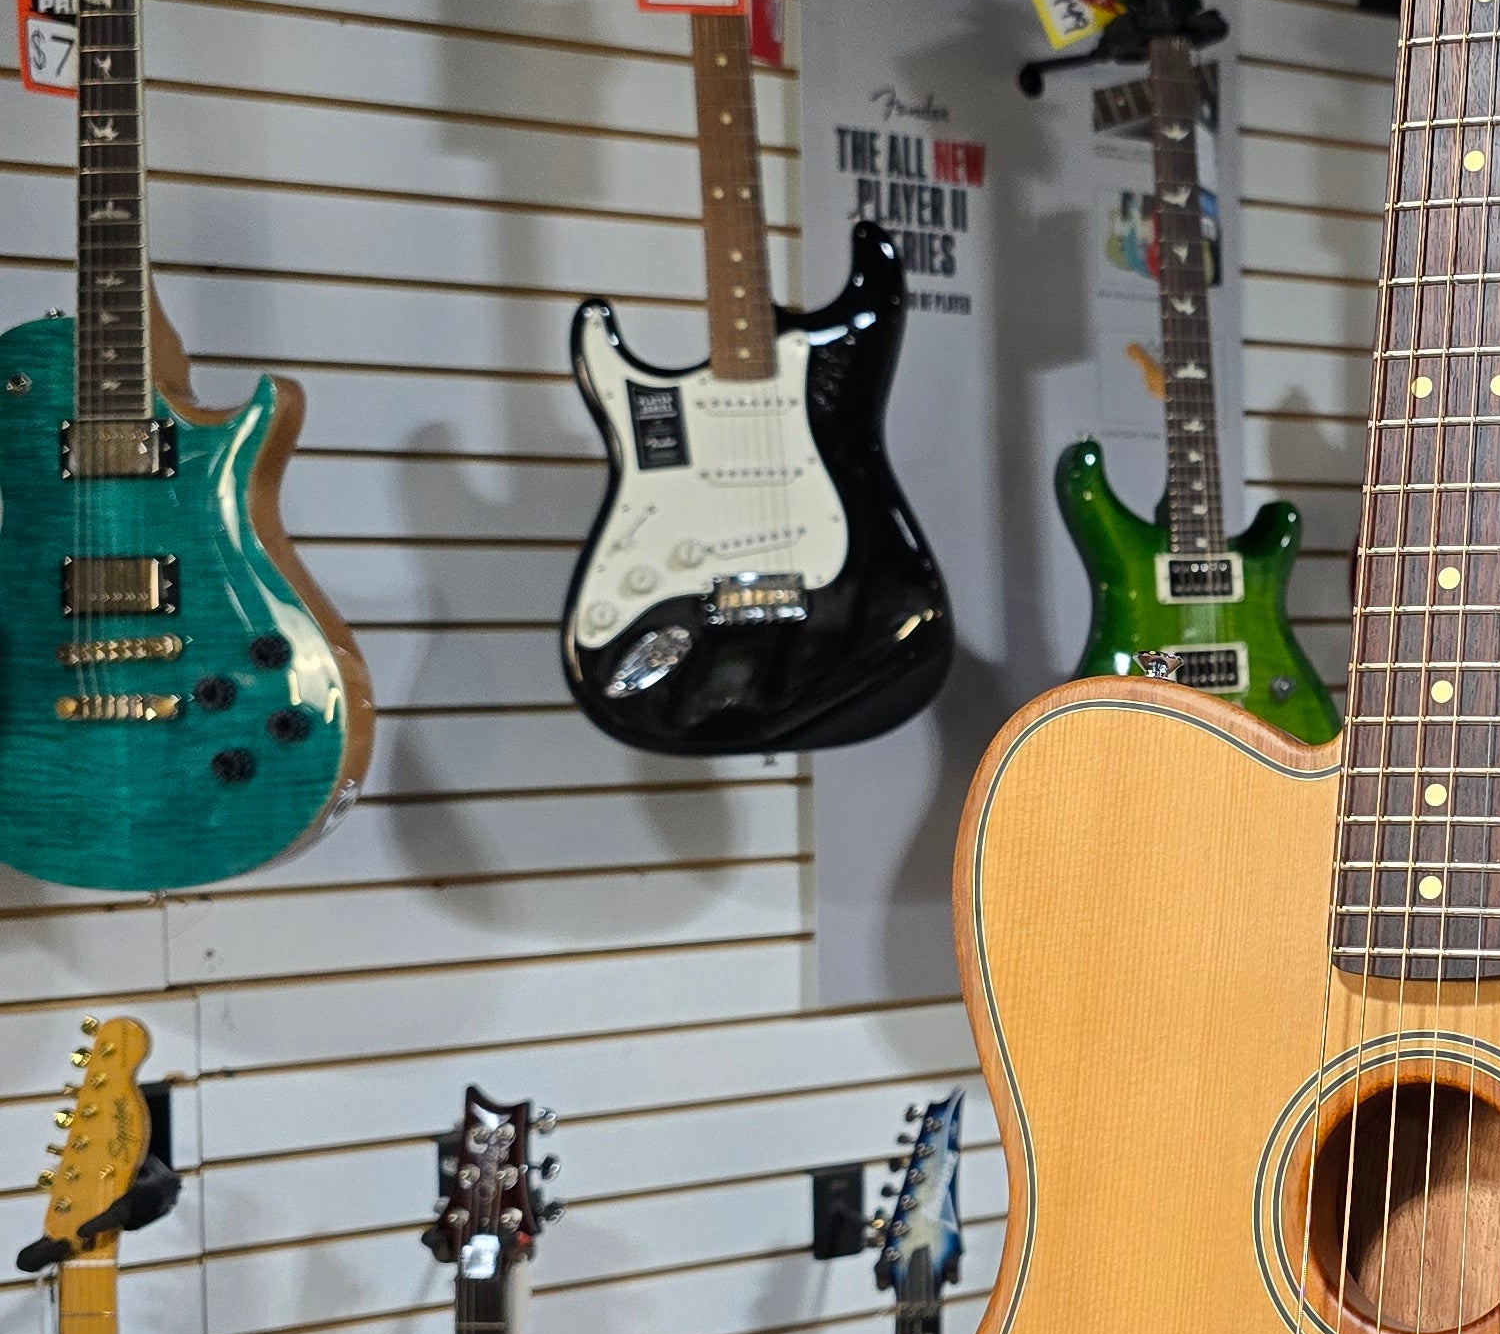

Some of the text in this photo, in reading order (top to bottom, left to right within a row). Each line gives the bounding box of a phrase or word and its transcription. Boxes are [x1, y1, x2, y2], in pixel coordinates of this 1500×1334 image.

[836, 123, 879, 176] THE
[887, 131, 928, 181] ALL
[857, 178, 945, 229] PLAYER
